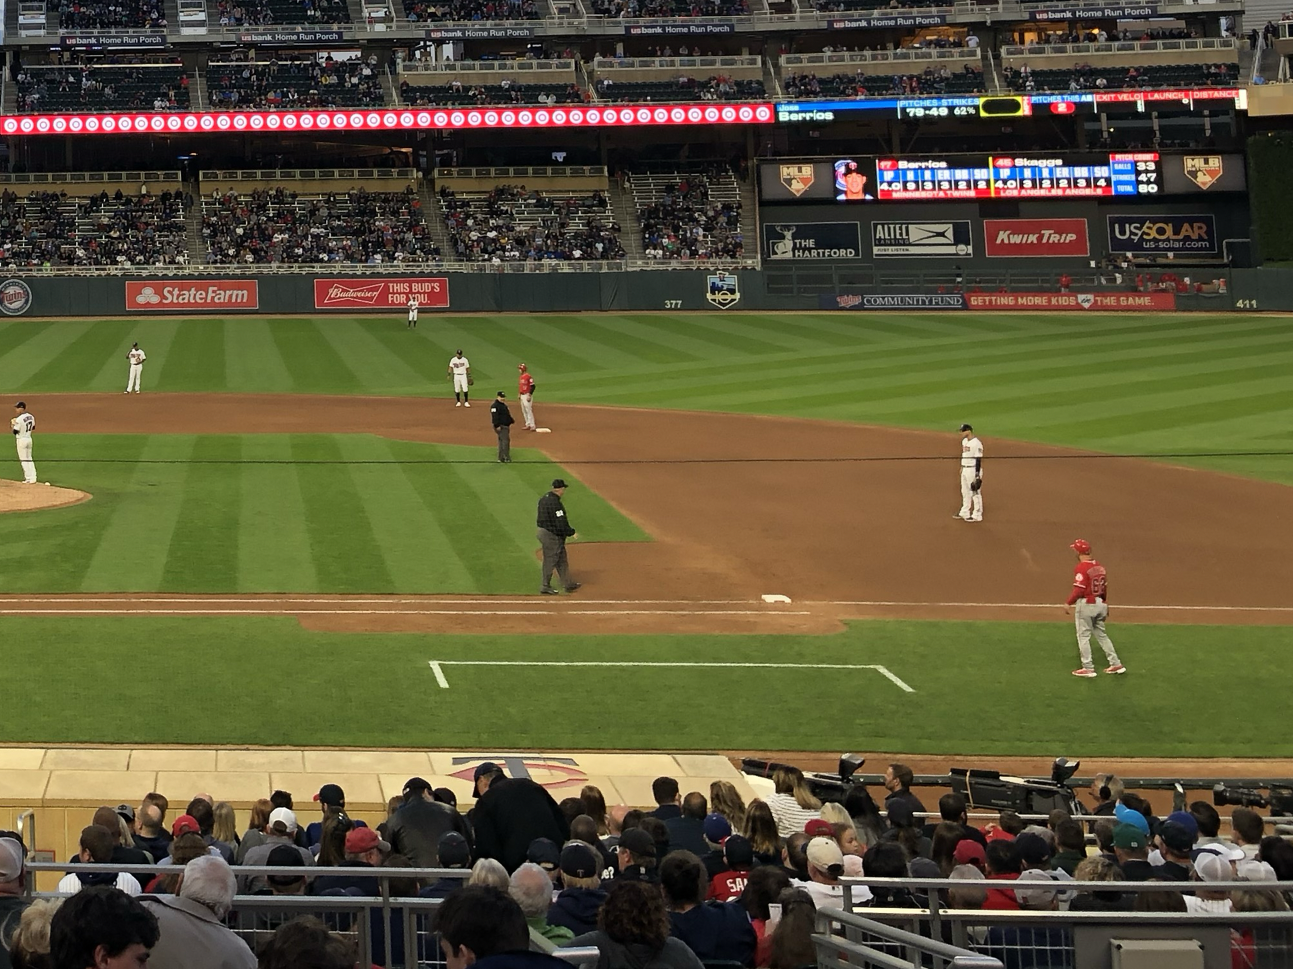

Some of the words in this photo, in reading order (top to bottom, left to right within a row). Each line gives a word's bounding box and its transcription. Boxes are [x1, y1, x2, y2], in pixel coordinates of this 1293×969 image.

[1075, 9, 1102, 19] Home
[1104, 8, 1122, 17] Run
[1124, 7, 1152, 15] Porch
[870, 18, 895, 27] Home
[897, 17, 914, 26] Run
[915, 16, 941, 24] Porch
[465, 30, 488, 38] Home
[490, 29, 505, 37] Run
[507, 28, 529, 36] Porch
[665, 25, 688, 34] Home
[690, 25, 705, 33] Run
[707, 24, 730, 33] Porch
[99, 36, 122, 44] Home
[123, 36, 138, 44] Run
[139, 35, 162, 44] Porch
[275, 33, 297, 41] Home
[299, 33, 314, 41] Run
[315, 32, 338, 40] Porch
[1032, 95, 1062, 103] PITCHES
[1064, 94, 1080, 102] THIS
[1081, 93, 1092, 102] AB
[1097, 94, 1114, 102] EXIT
[1116, 92, 1141, 101] VELO
[1148, 91, 1185, 99] LAUNCH
[1193, 90, 1239, 98] DISTANCE
[954, 106, 975, 115] 62%
[1014, 158, 1063, 167] Skaggs
[1187, 158, 1219, 167] MLB
[783, 166, 811, 176] MLB
[875, 224, 908, 239] ALTEC
[795, 239, 815, 247] THE
[1143, 240, 1209, 248] us-solar.com
[795, 249, 855, 258] HARTFORD
[388, 283, 409, 293] THIS
[411, 283, 440, 293] BUD'S
[1, 290, 28, 306] Twins
[333, 288, 378, 299] Budweiser
[388, 293, 406, 303] FOR
[664, 300, 682, 309] 377
[837, 295, 862, 308] Twins
[864, 296, 930, 305] COMMUNITY
[932, 296, 962, 305] FUND
[970, 296, 1015, 305] GETTING
[1018, 296, 1048, 305] MORE
[1051, 296, 1076, 305] KIDS
[1096, 296, 1117, 305] THE
[1119, 296, 1155, 305] GAME.
[1236, 299, 1257, 309] 411
